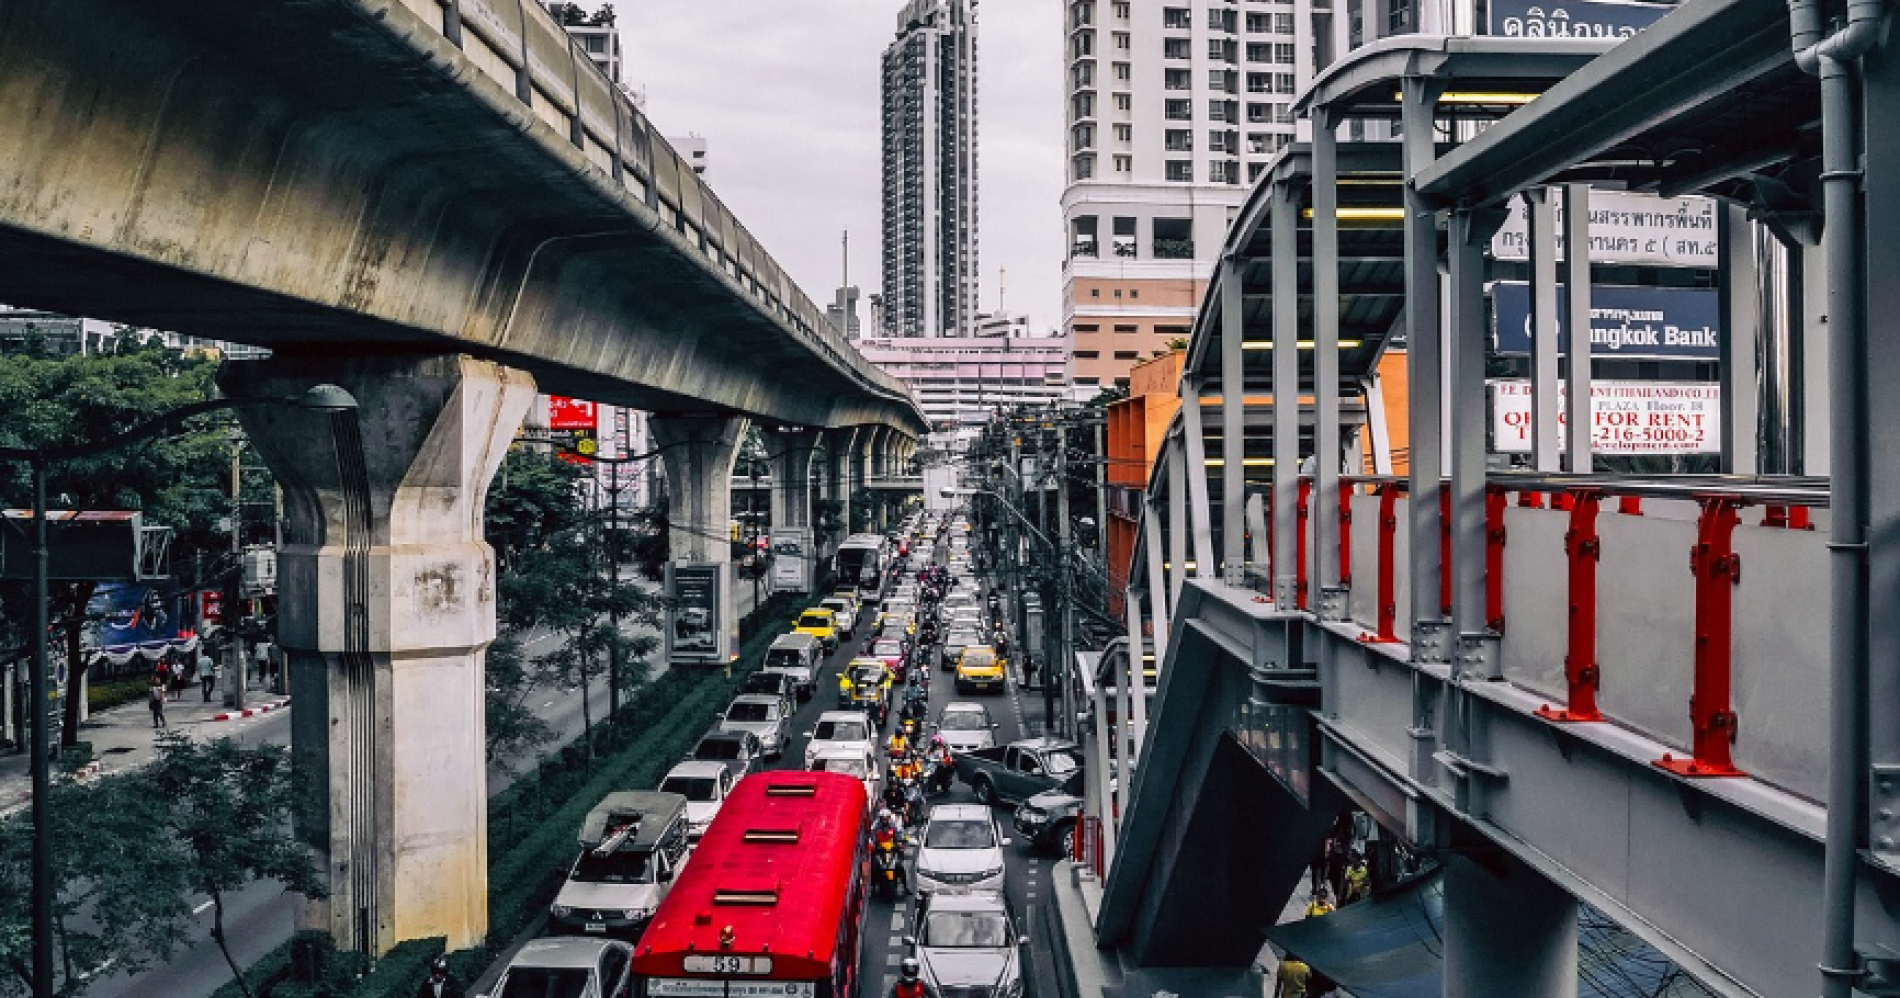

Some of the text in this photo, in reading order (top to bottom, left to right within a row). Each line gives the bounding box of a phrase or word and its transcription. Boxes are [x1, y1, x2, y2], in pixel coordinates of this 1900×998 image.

[1503, 5, 1646, 37] คลินิกนอ
[1590, 324, 1717, 350] ngkok Bank
[1595, 411, 1640, 427] FOR
[1648, 412, 1706, 428] RENT
[1592, 427, 1705, 442] -216-5000-2
[1590, 440, 1699, 451] development.com
[713, 956, 741, 973] 59
